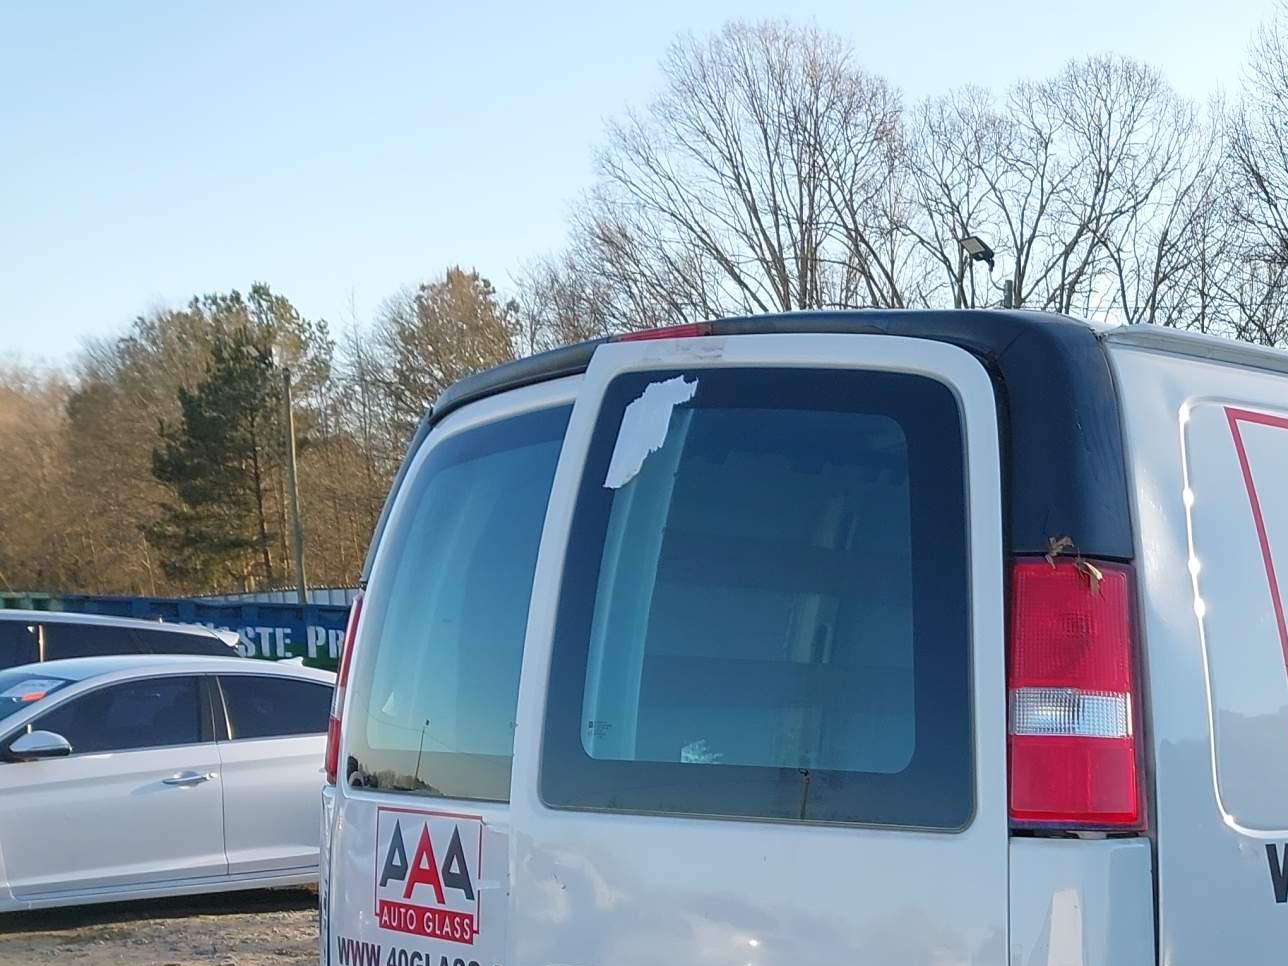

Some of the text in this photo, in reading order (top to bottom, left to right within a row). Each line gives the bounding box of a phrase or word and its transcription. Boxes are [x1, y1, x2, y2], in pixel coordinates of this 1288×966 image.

[379, 818, 475, 904] AAA
[381, 905, 472, 941] AUTO GLASS
